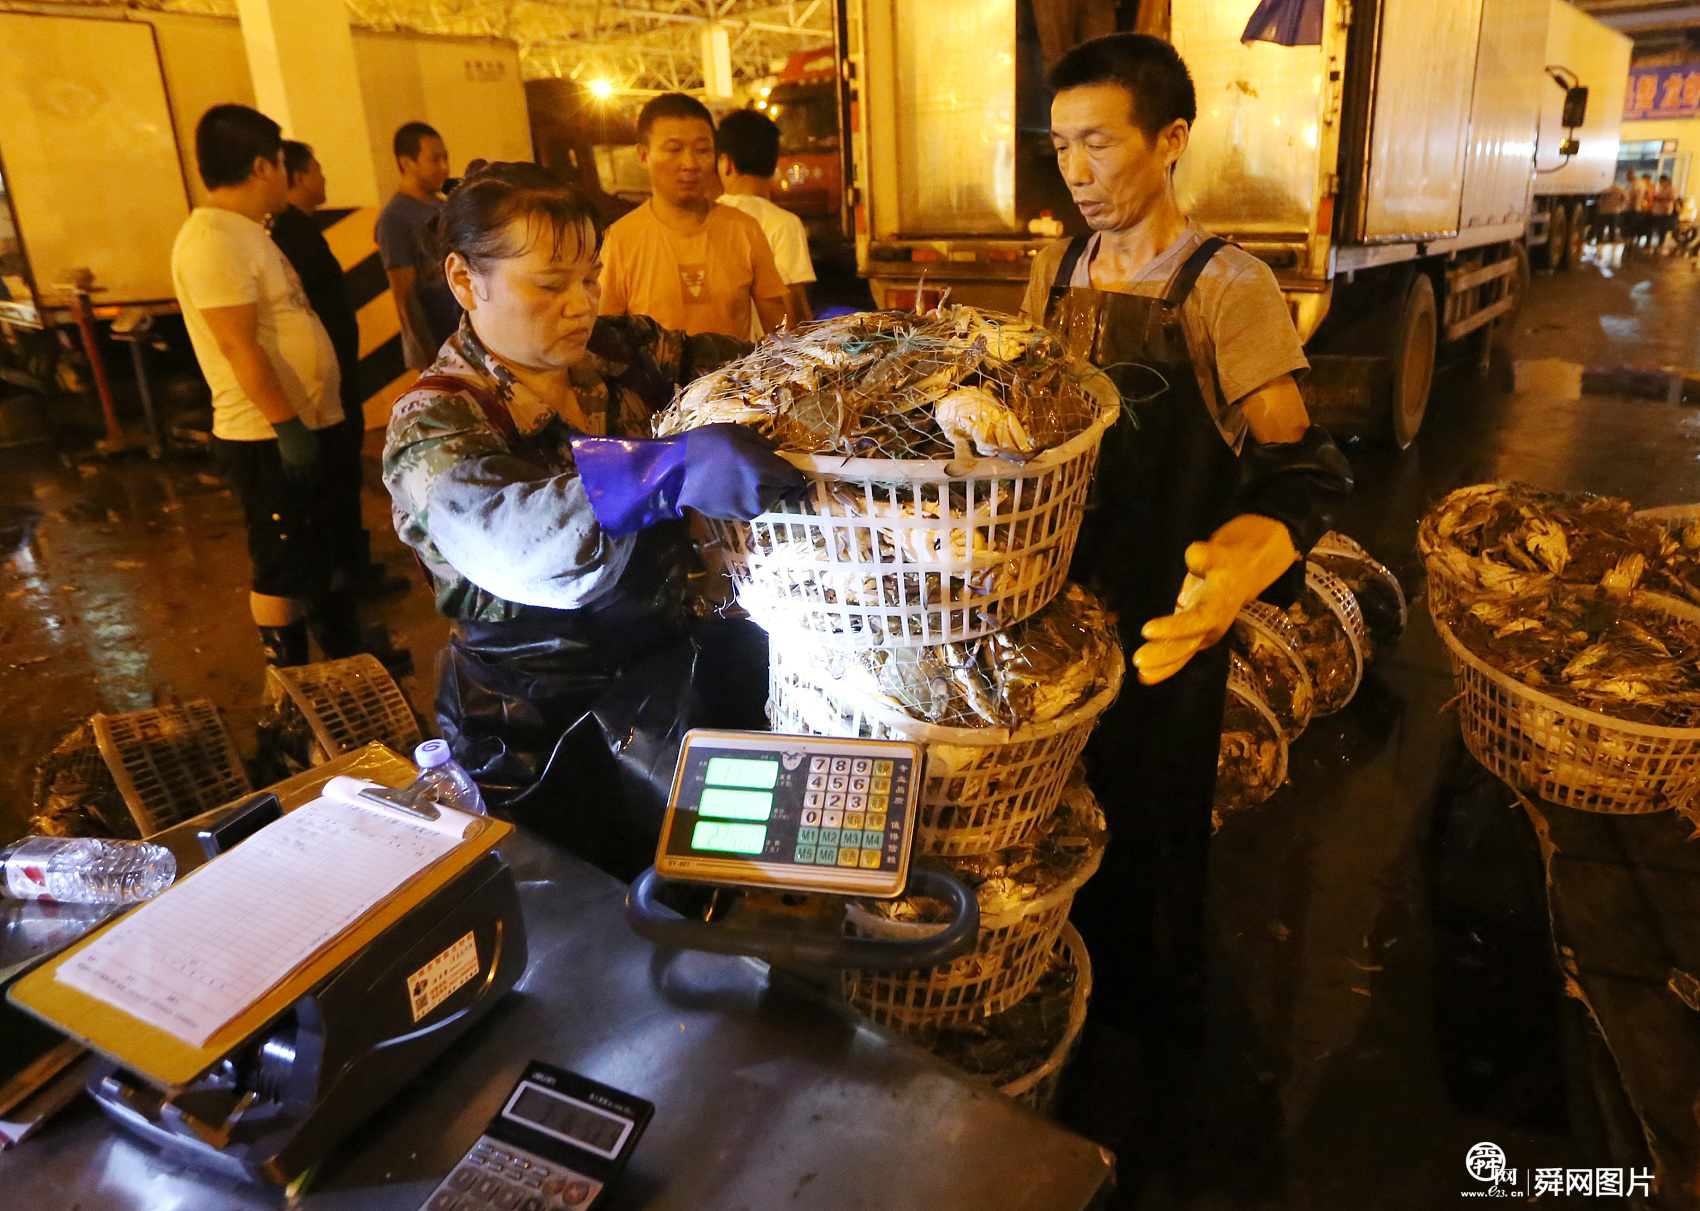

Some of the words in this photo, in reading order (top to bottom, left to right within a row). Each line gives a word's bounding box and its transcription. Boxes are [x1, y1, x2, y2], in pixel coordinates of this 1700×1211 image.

[816, 759, 826, 771] 7
[835, 760, 847, 772] 8
[856, 761, 867, 773] 9
[811, 776, 823, 788] 4
[832, 777, 843, 789] 5
[853, 778, 865, 791] 6
[811, 793, 818, 806] 1
[829, 794, 841, 807] 2
[851, 796, 862, 808] 3
[806, 811, 817, 823] 0
[802, 831, 815, 842] M1
[821, 831, 837, 843] M2
[843, 833, 859, 844] M3
[865, 834, 880, 845] M4
[797, 848, 812, 860] M5
[820, 851, 834, 863] M6
